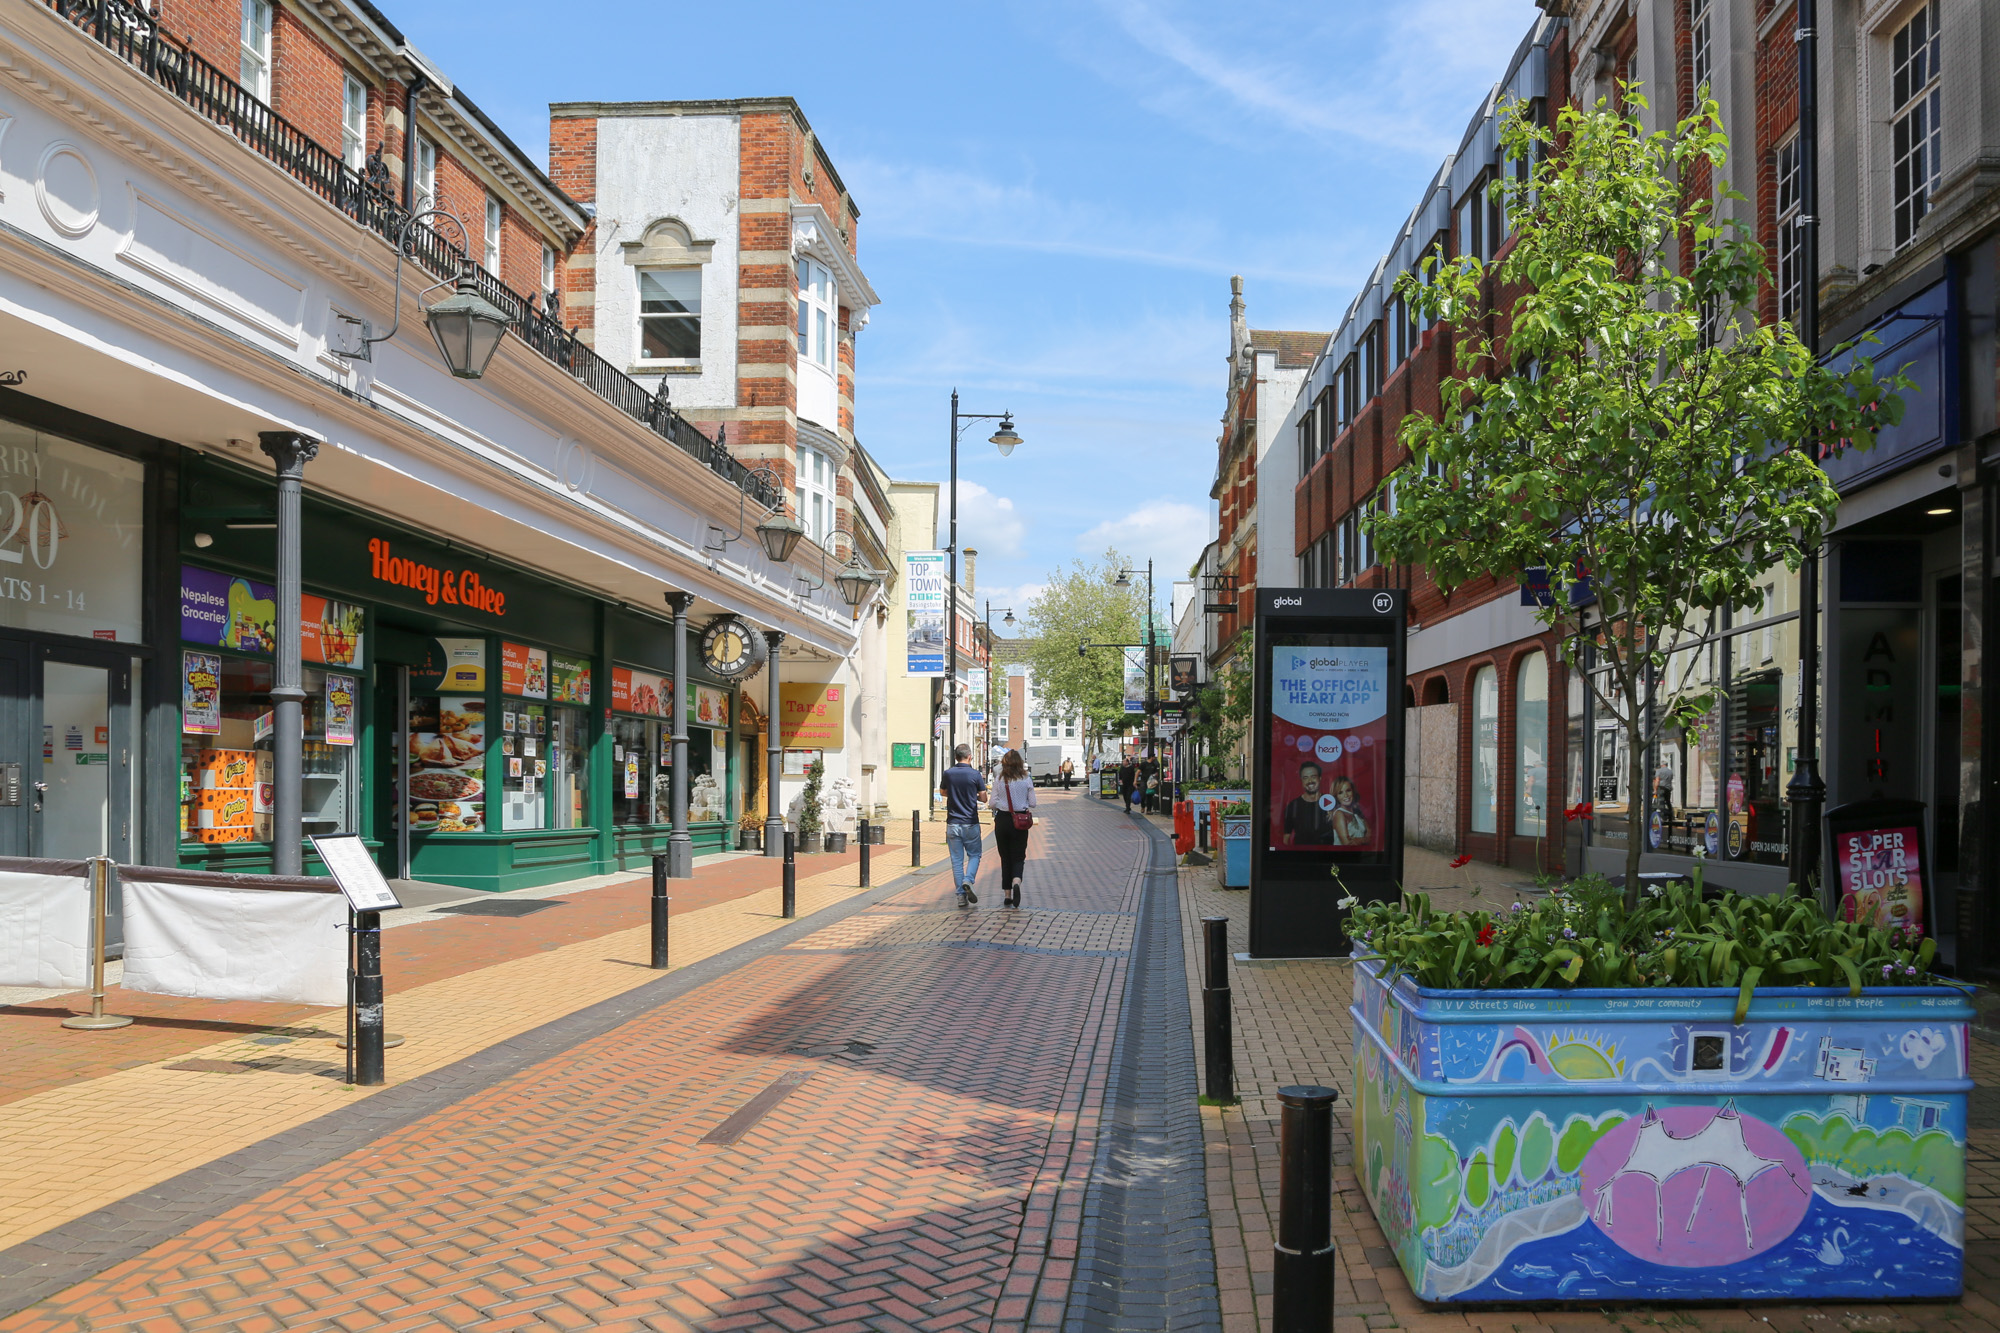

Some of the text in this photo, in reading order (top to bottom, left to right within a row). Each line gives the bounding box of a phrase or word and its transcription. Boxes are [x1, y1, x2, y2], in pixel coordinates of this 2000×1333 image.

[0, 490, 58, 570] 20
[909, 563, 929, 576] TOP
[368, 537, 507, 617] Honey & Ghee
[909, 578, 942, 591] TOWN
[39, 584, 47, 605] 1
[66, 589, 86, 611] 14
[180, 585, 225, 607] Nepalese
[1273, 597, 1388, 608] global BT
[181, 605, 226, 624] Groceries
[502, 647, 517, 659] Indian
[502, 658, 524, 670] Groceries
[188, 673, 216, 684] CIRCUS
[1280, 679, 1379, 693] THE OFFICIAL
[1289, 692, 1371, 705] HEART APP
[786, 700, 828, 717] Tang
[1317, 744, 1339, 753] heart
[225, 760, 247, 783] Cheetos
[224, 798, 246, 822] Cheetos
[1750, 841, 1789, 854] OPEN 24 HOURS
[1849, 833, 1905, 853] SUPER
[1850, 848, 1907, 873] STAR
[1850, 868, 1909, 891] SLOTS
[1513, 1001, 1536, 1010] alive
[1604, 999, 1702, 1009] grow your community
[1807, 997, 1823, 1007] love
[1824, 998, 1835, 1007] all
[1837, 998, 1851, 1007] the
[1921, 998, 1962, 1007] add colour
